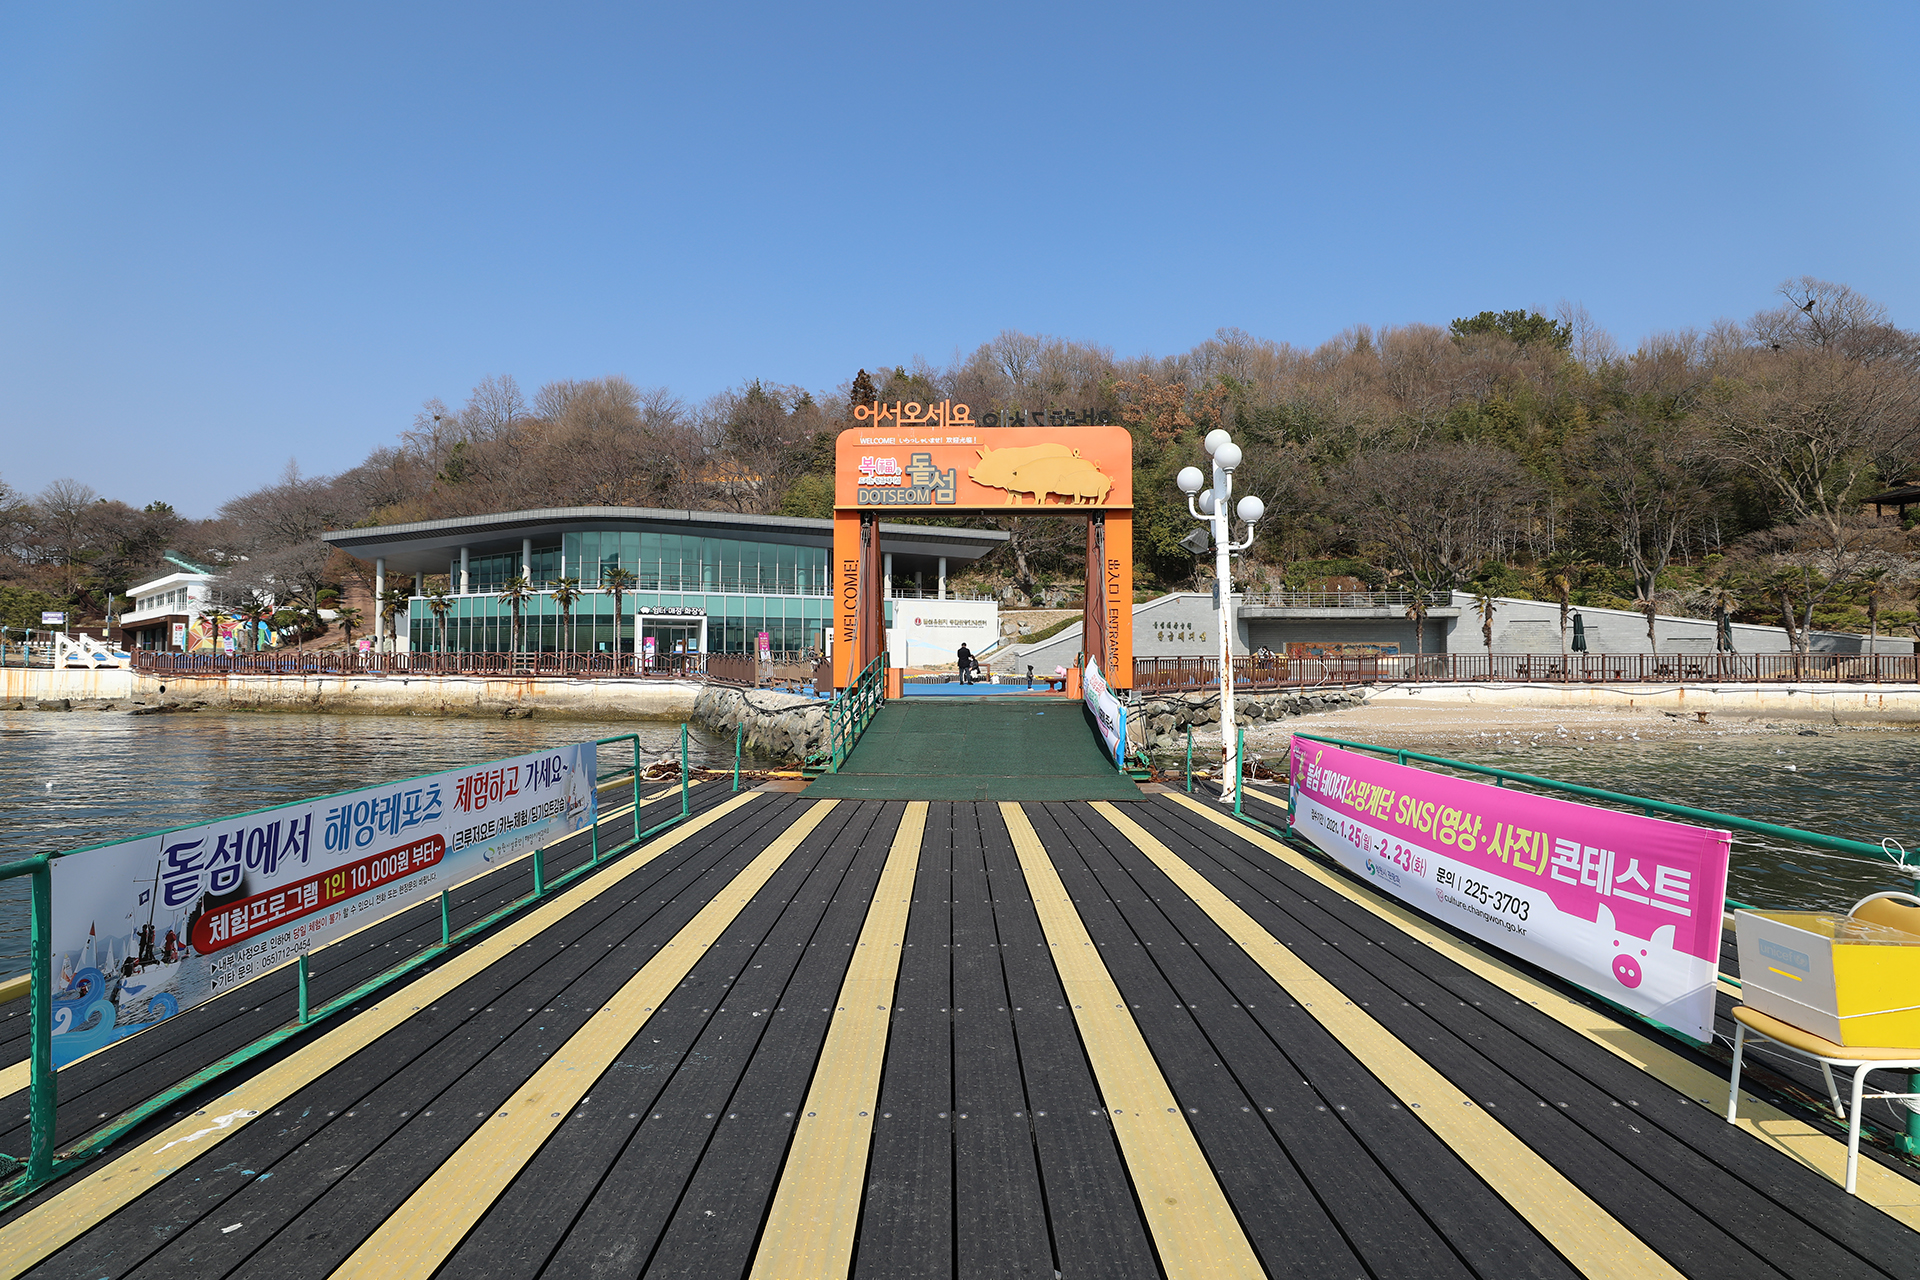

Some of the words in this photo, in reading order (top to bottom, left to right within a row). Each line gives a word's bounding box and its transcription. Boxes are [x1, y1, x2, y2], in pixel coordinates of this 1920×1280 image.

[854, 399, 975, 428] 어서오세요
[858, 489, 930, 503] DOTSEOM
[905, 454, 955, 503] 돝섬
[844, 560, 859, 642] WELCOME!
[1107, 560, 1120, 595] 出入口
[1108, 608, 1119, 672] ENTRANCE
[1306, 763, 1322, 792] 돝섬
[161, 812, 312, 907] 돝섬에서
[324, 783, 443, 851] 해양레포츠
[453, 766, 520, 813] 체험하고
[525, 755, 568, 792] 가세요~
[209, 881, 318, 944] 체험프로그램
[324, 871, 345, 900] 1인
[351, 849, 409, 890] 10,000원
[412, 841, 441, 866] 부터~
[1436, 867, 1456, 888] 문의
[1464, 879, 1530, 922] 225-3703
[1444, 893, 1527, 937] culture.changwon.go.kr
[218, 954, 235, 970] 내부
[237, 941, 268, 963] 사정으로
[270, 931, 291, 949] 인하여
[293, 924, 307, 940] 당일
[308, 915, 327, 932] 체험이
[329, 909, 341, 925] 불가
[342, 907, 349, 919] 할
[350, 905, 357, 915] 수
[357, 896, 374, 912] 있으니
[375, 892, 386, 905] 전화
[387, 889, 398, 900] 또는
[1759, 944, 1794, 963] unicef
[219, 970, 235, 987] 기타
[238, 961, 253, 980] 문의
[261, 938, 311, 968] 055)712-0454
